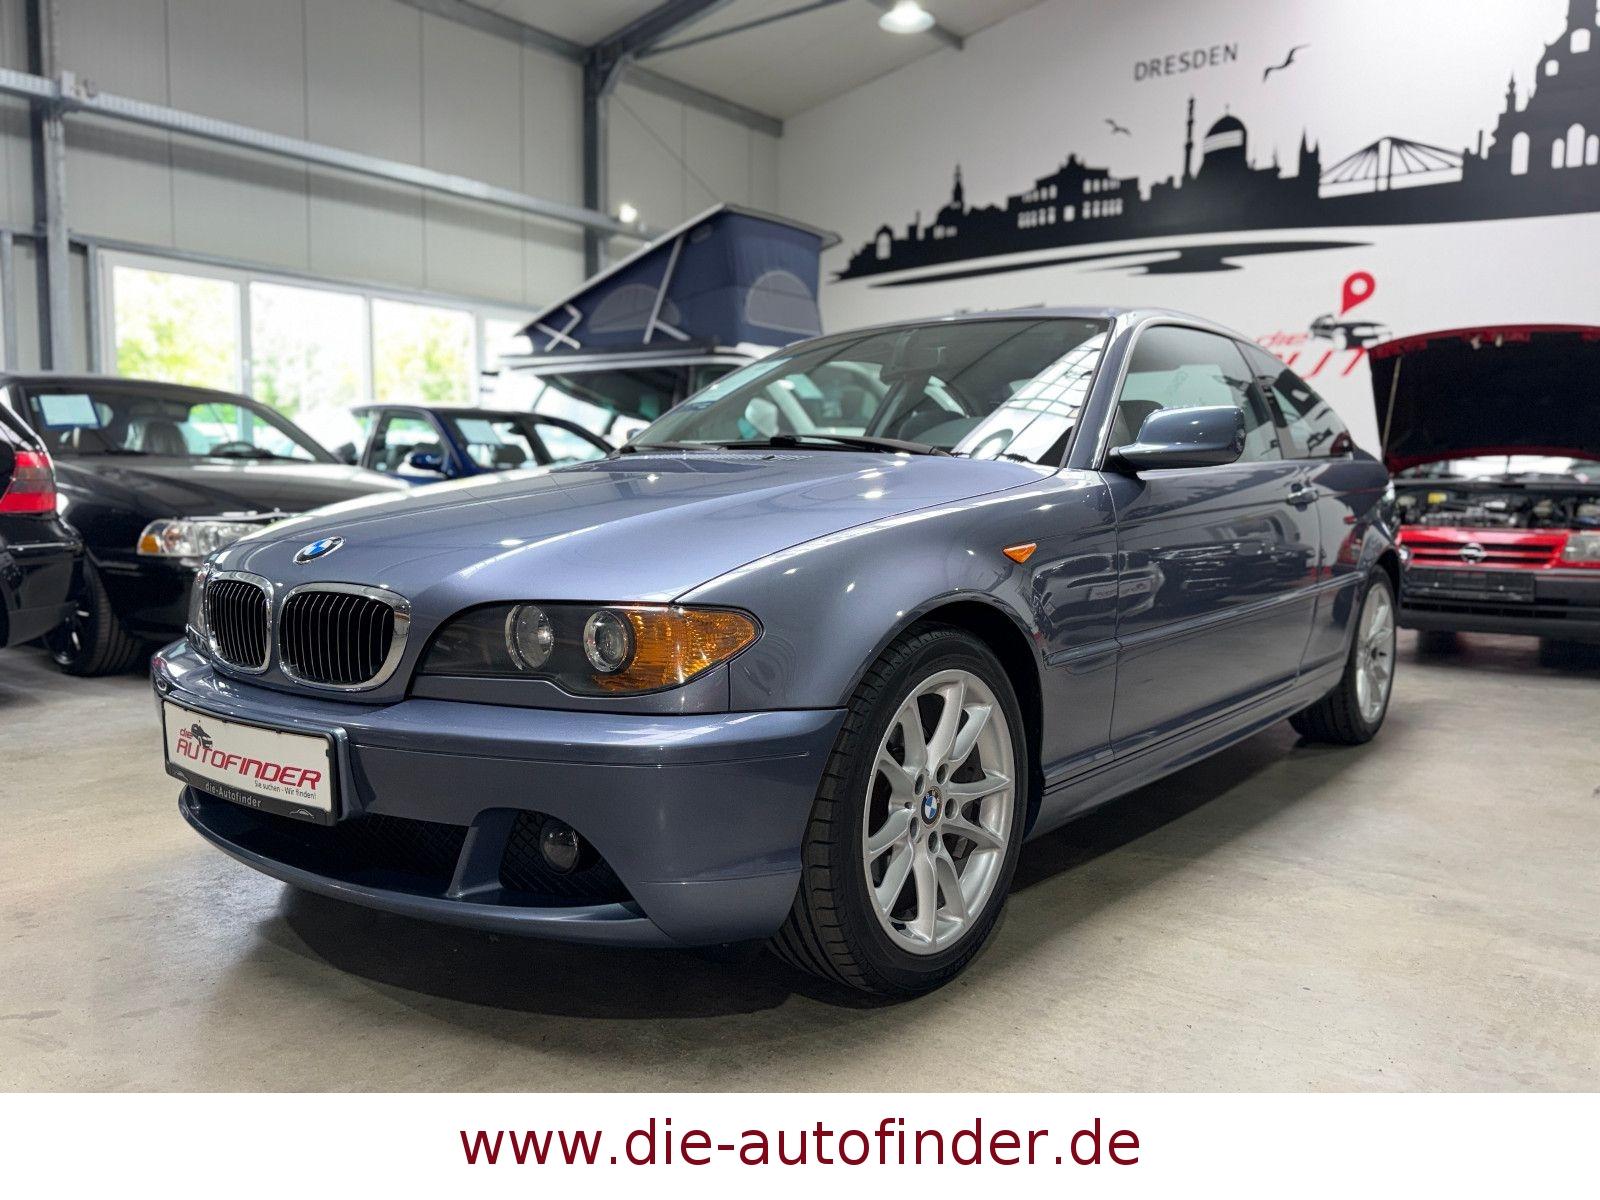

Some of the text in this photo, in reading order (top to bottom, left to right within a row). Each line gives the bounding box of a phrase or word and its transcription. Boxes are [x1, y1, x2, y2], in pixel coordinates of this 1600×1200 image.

[1133, 43, 1239, 82] DRESDEN
[176, 738, 322, 790] AUTOFINDER
[205, 781, 263, 808] die-Autofinder
